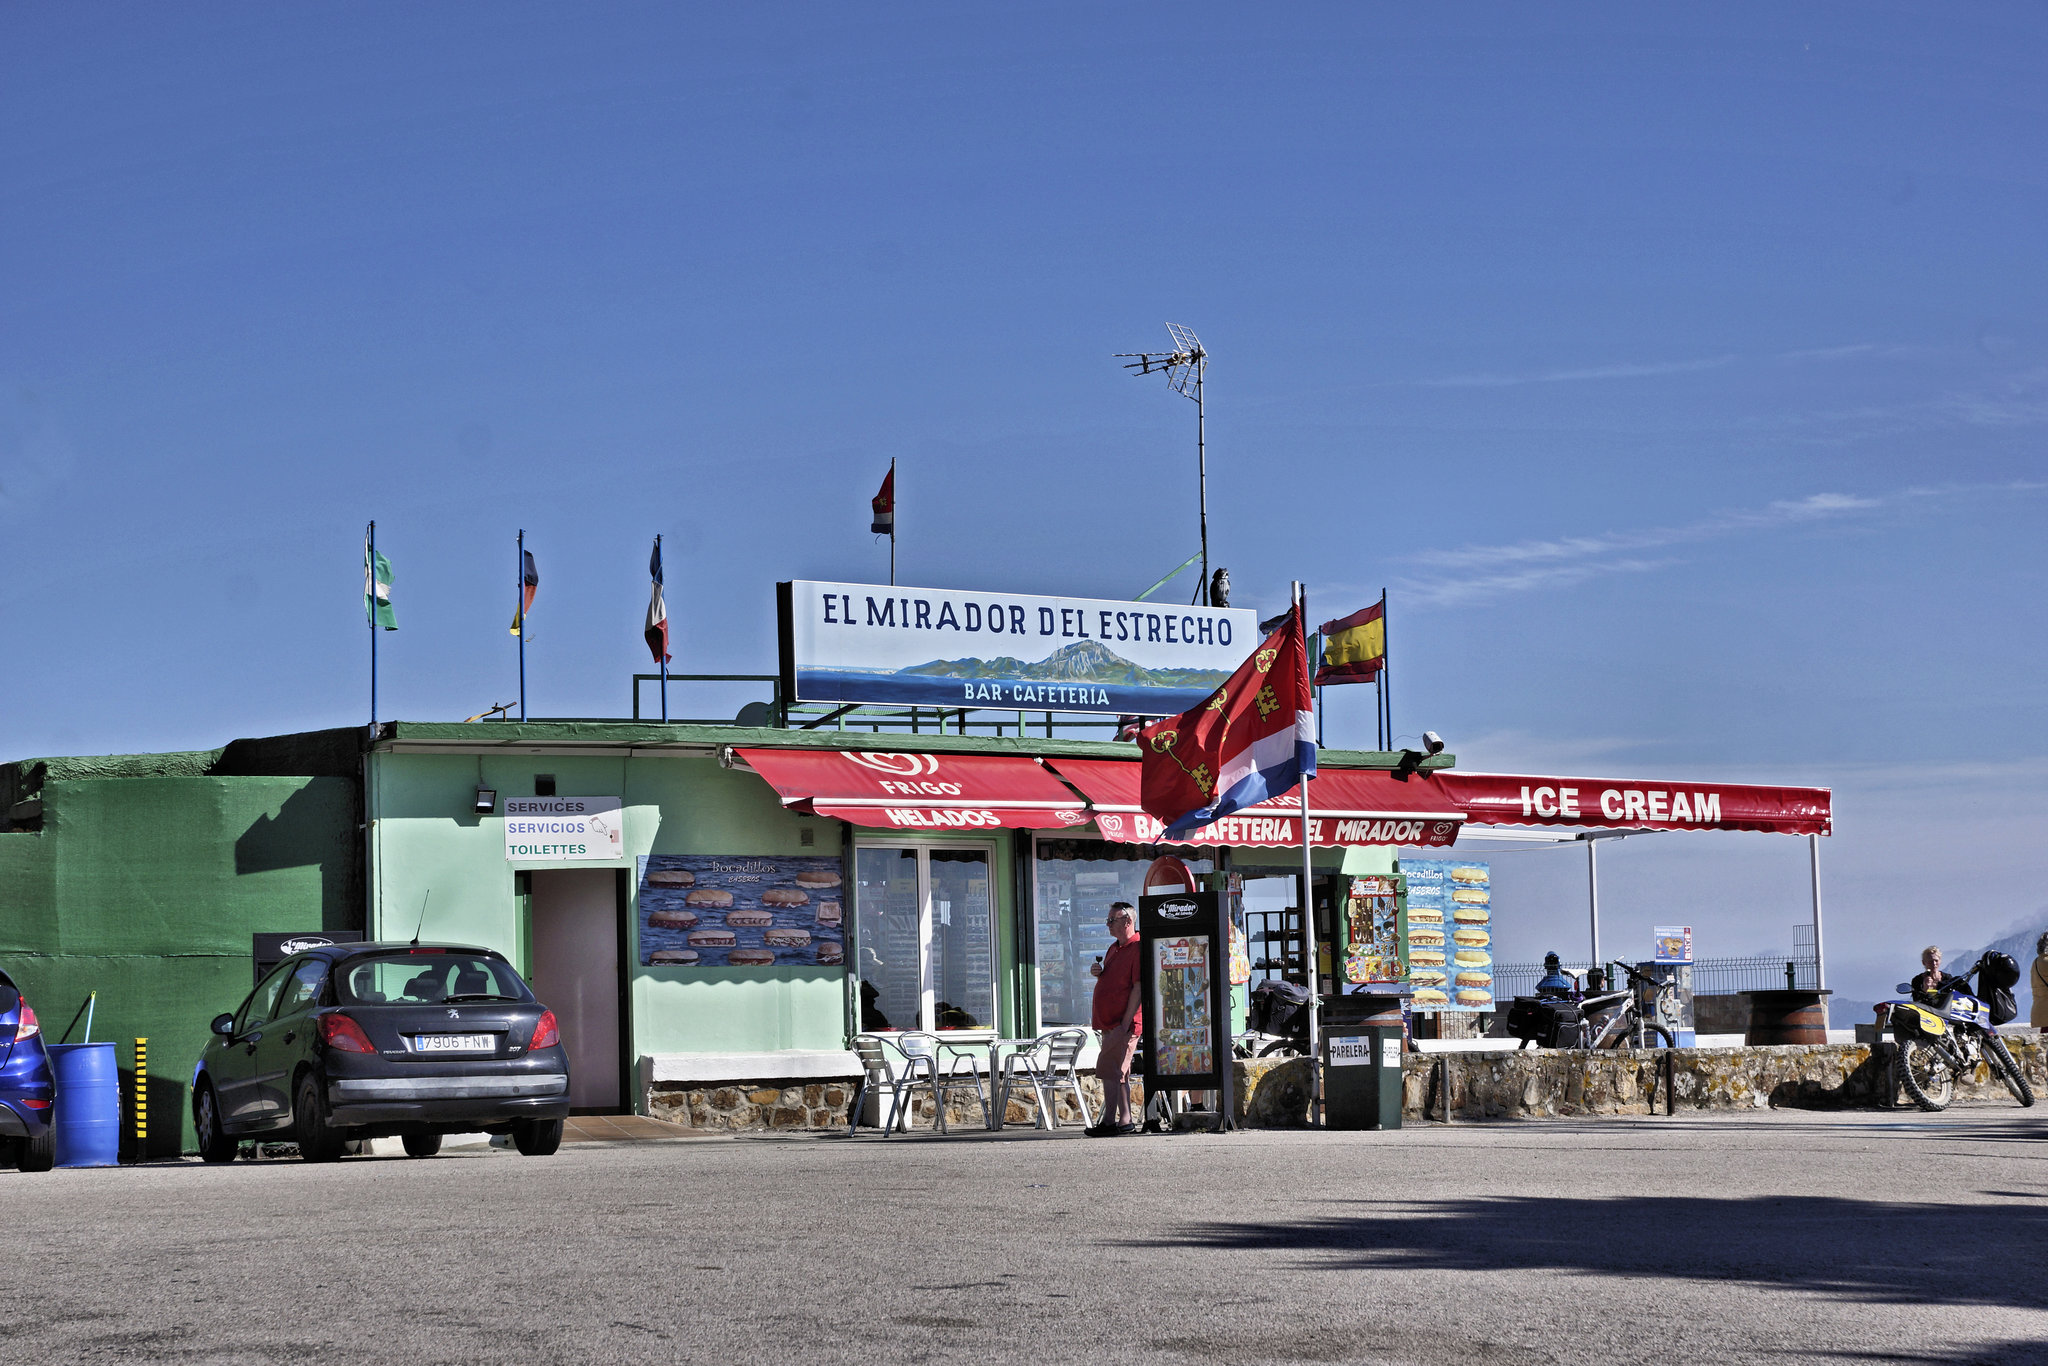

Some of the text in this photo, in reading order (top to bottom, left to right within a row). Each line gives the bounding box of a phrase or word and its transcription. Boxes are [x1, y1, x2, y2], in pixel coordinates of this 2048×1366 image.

[823, 593, 1232, 647] EL MIRADOR DEL ESTRECHO
[964, 683, 1110, 706] BAR CAFETERÍA
[878, 780, 962, 796] FRIGO
[508, 802, 585, 812] SERVICES
[1520, 786, 1722, 823] ICE CREAM
[885, 809, 1001, 827] HELADOS
[508, 823, 585, 833] SERVICIOS
[1134, 815, 1168, 839] BA
[1308, 819, 1324, 842] EL
[1334, 820, 1425, 842] MIRADOR
[509, 844, 587, 854] TOILETTES
[710, 861, 776, 874] Bocadillos
[424, 1036, 489, 1048] 7906 FNW
[1332, 1044, 1368, 1058] PAPELERA
